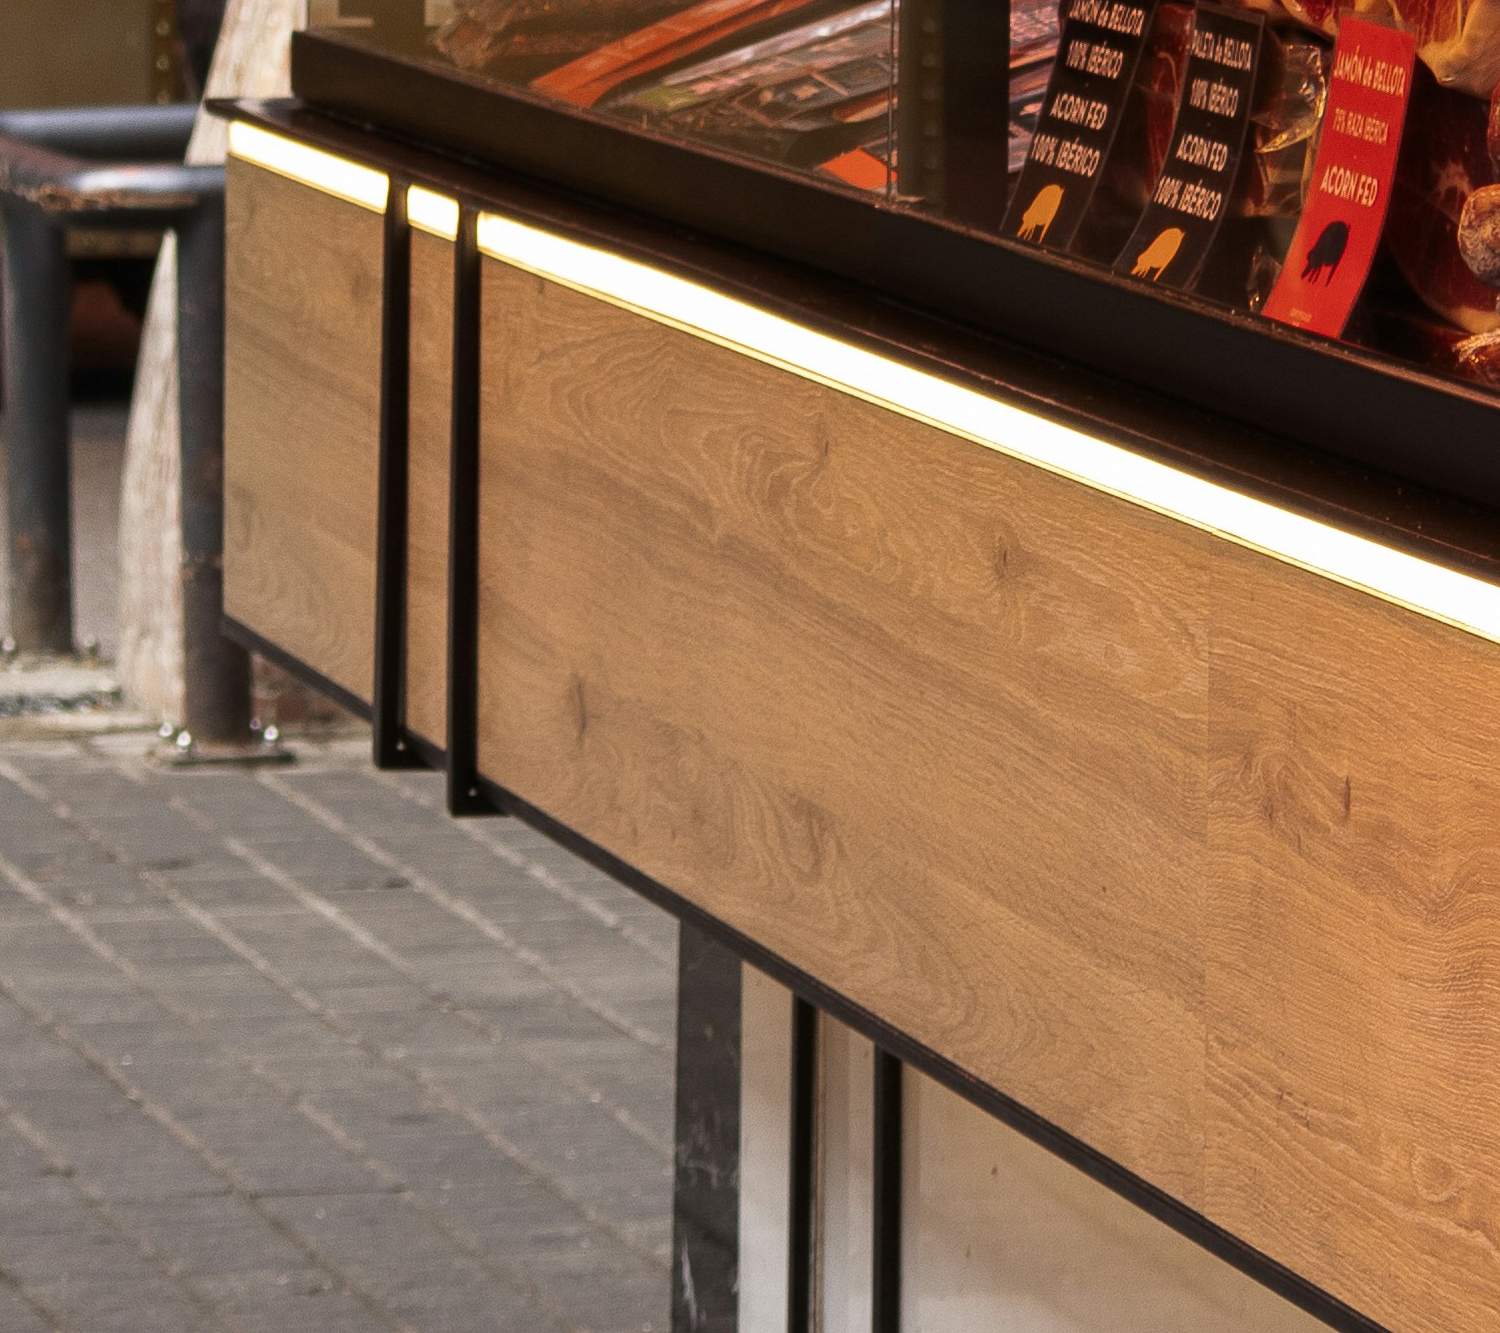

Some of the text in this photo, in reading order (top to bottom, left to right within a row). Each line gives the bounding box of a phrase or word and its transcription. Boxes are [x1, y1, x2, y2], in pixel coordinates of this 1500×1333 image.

[1098, 5, 1110, 28] de
[1108, 1, 1146, 37] BELLOTA
[1064, 38, 1125, 81] 100% IBÉRICO
[1214, 40, 1225, 62] de
[1223, 37, 1252, 73] BELLOTA
[1334, 44, 1406, 96] JAMÓN de BELLOTA
[1049, 92, 1109, 131] ACORN FED
[1190, 77, 1240, 119] 100% IBÉRICO
[1347, 112, 1366, 140] RAZA
[1364, 116, 1389, 146] IBÉRICA
[1029, 132, 1102, 179] 100% IBÉRICO
[1175, 132, 1229, 173] ACORN FED
[1153, 174, 1223, 222] 100% IBÉRICO
[1319, 164, 1379, 208] ACORN FED
